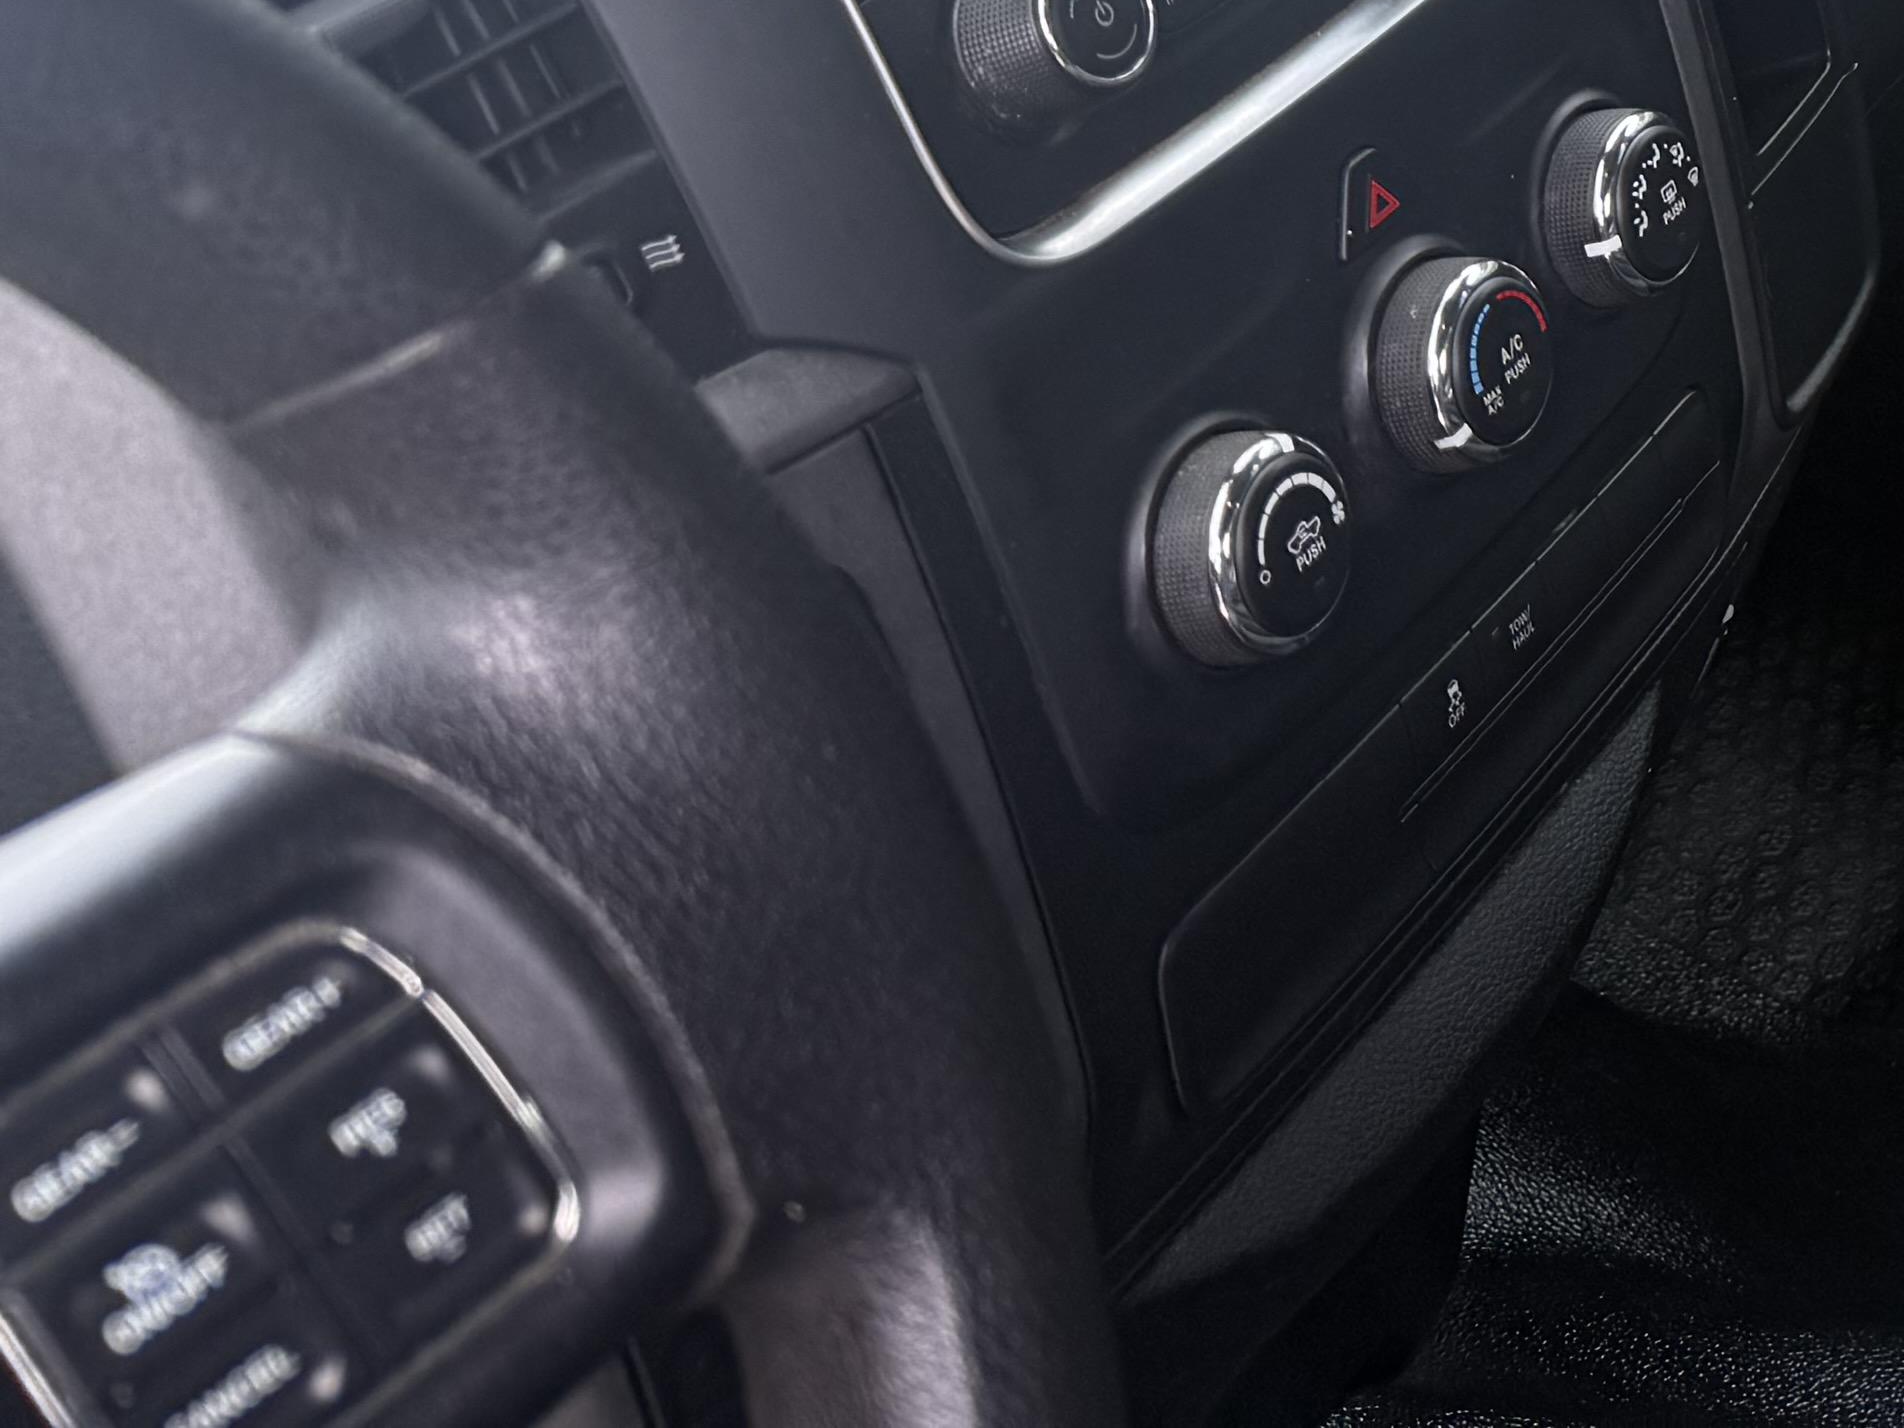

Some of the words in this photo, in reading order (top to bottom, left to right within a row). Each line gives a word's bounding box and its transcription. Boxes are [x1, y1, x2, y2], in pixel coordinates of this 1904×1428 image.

[1662, 196, 1687, 225] PUSH
[1501, 333, 1524, 365] A/C
[1504, 352, 1532, 384] PUSH
[1483, 385, 1502, 406] MAX
[1296, 535, 1327, 572] PUSH
[1512, 621, 1535, 650] HAUL
[1448, 702, 1465, 728] OFF
